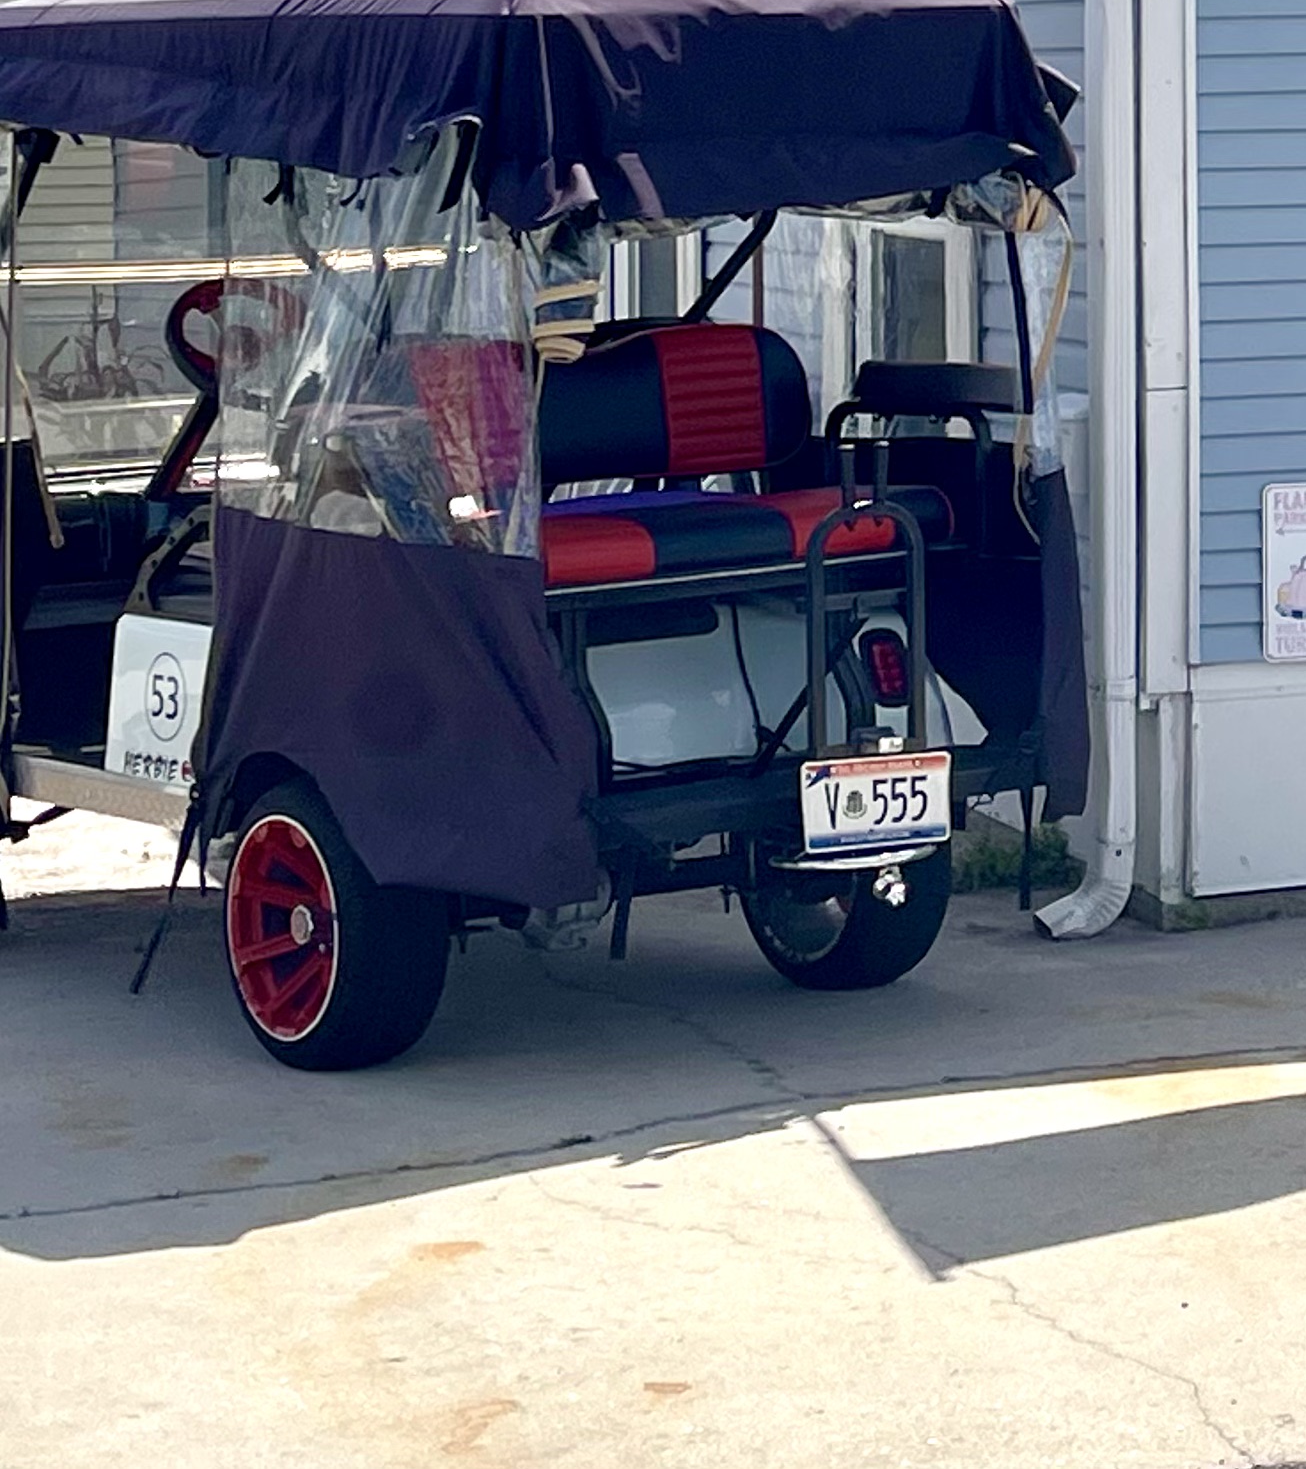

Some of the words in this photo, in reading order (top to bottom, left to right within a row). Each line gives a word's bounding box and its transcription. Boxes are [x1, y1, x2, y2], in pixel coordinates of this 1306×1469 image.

[151, 674, 179, 720] 53
[124, 750, 179, 781] HERBIE
[824, 782, 840, 830] V
[872, 775, 928, 826] 555
